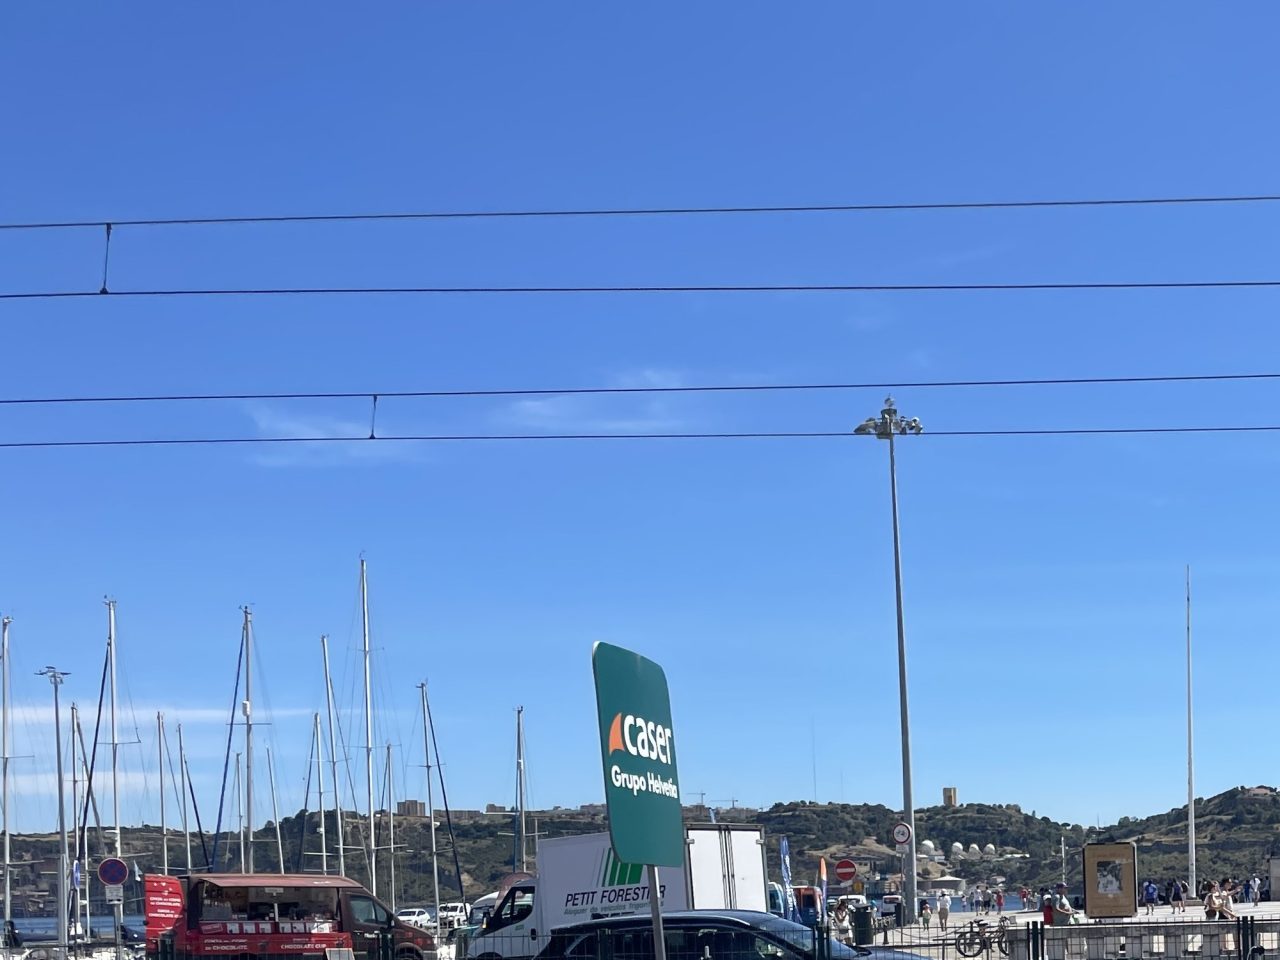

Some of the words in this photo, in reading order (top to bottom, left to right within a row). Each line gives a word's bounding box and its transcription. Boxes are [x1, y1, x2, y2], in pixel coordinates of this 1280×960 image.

[624, 714, 671, 765] caser
[611, 765, 647, 796] Grupo
[647, 771, 678, 799] Helvetia
[565, 891, 598, 907] PETIT
[600, 885, 666, 904] FORESTIR
